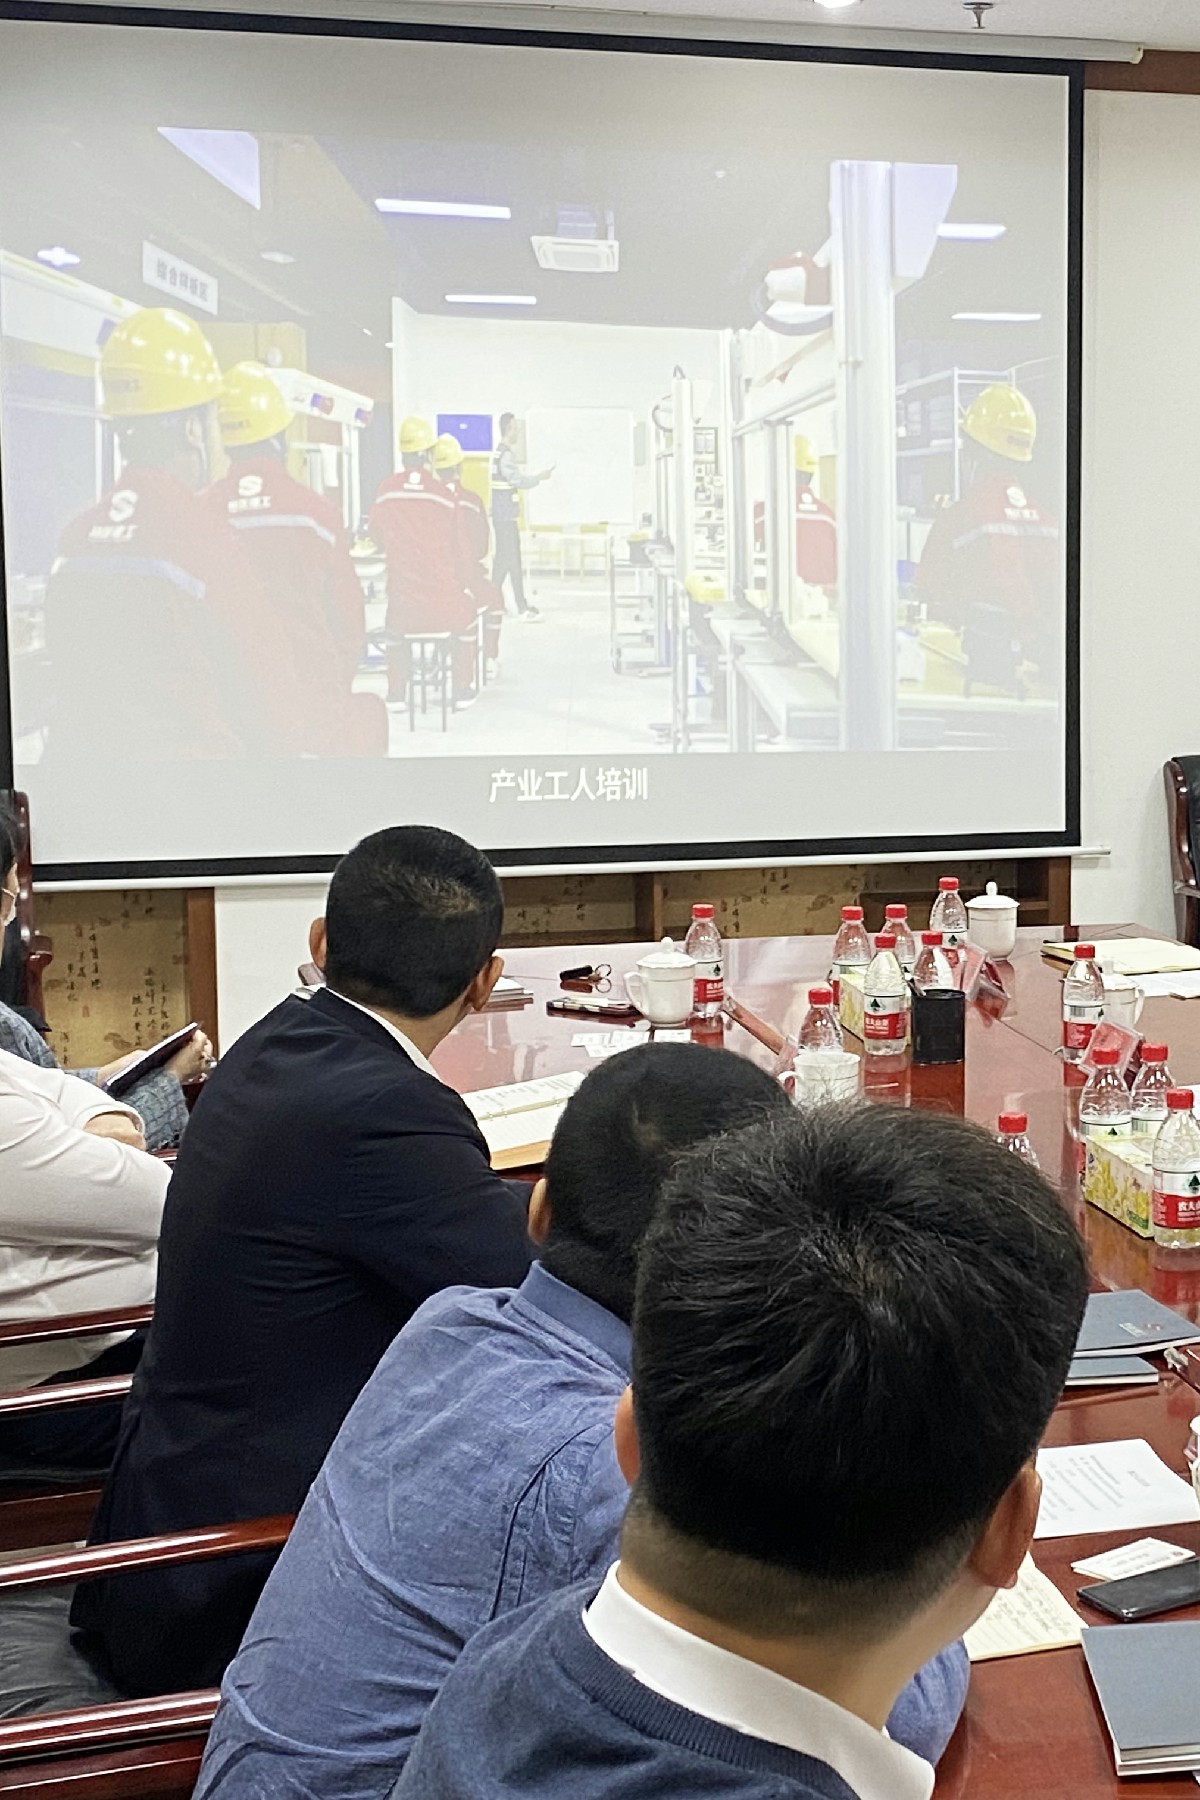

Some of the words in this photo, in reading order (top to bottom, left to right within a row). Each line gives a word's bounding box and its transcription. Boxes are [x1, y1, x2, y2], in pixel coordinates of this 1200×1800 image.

[489, 767, 648, 803] 产业工人培训
